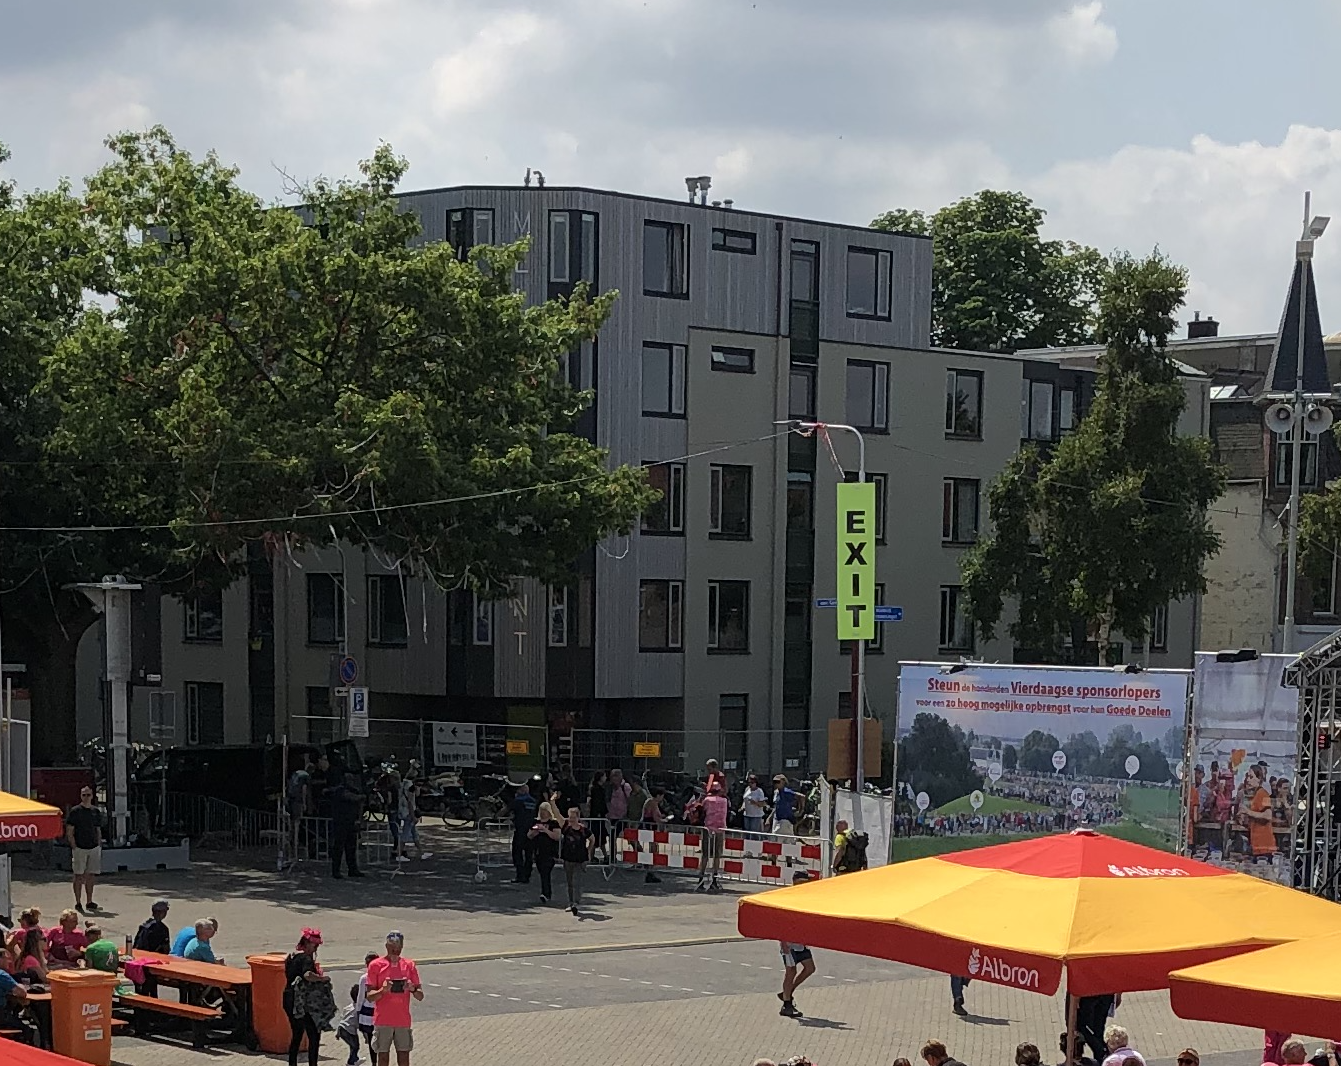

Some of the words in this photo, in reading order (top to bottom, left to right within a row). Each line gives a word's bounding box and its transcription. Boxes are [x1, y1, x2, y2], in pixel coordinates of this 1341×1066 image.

[844, 510, 868, 628] EXIT
[927, 677, 960, 692] Steun
[1010, 681, 1074, 698] Vierdaagse
[1076, 684, 1161, 700] sponsorlopers
[915, 699, 932, 707] voor
[945, 700, 956, 709] zo
[957, 698, 980, 711] hoog
[981, 699, 1024, 713] mogelijke
[1025, 702, 1072, 715] opbrengst
[1106, 704, 1137, 716] Goede
[1138, 705, 1171, 718] Doelen
[980, 955, 1039, 988] Albron
